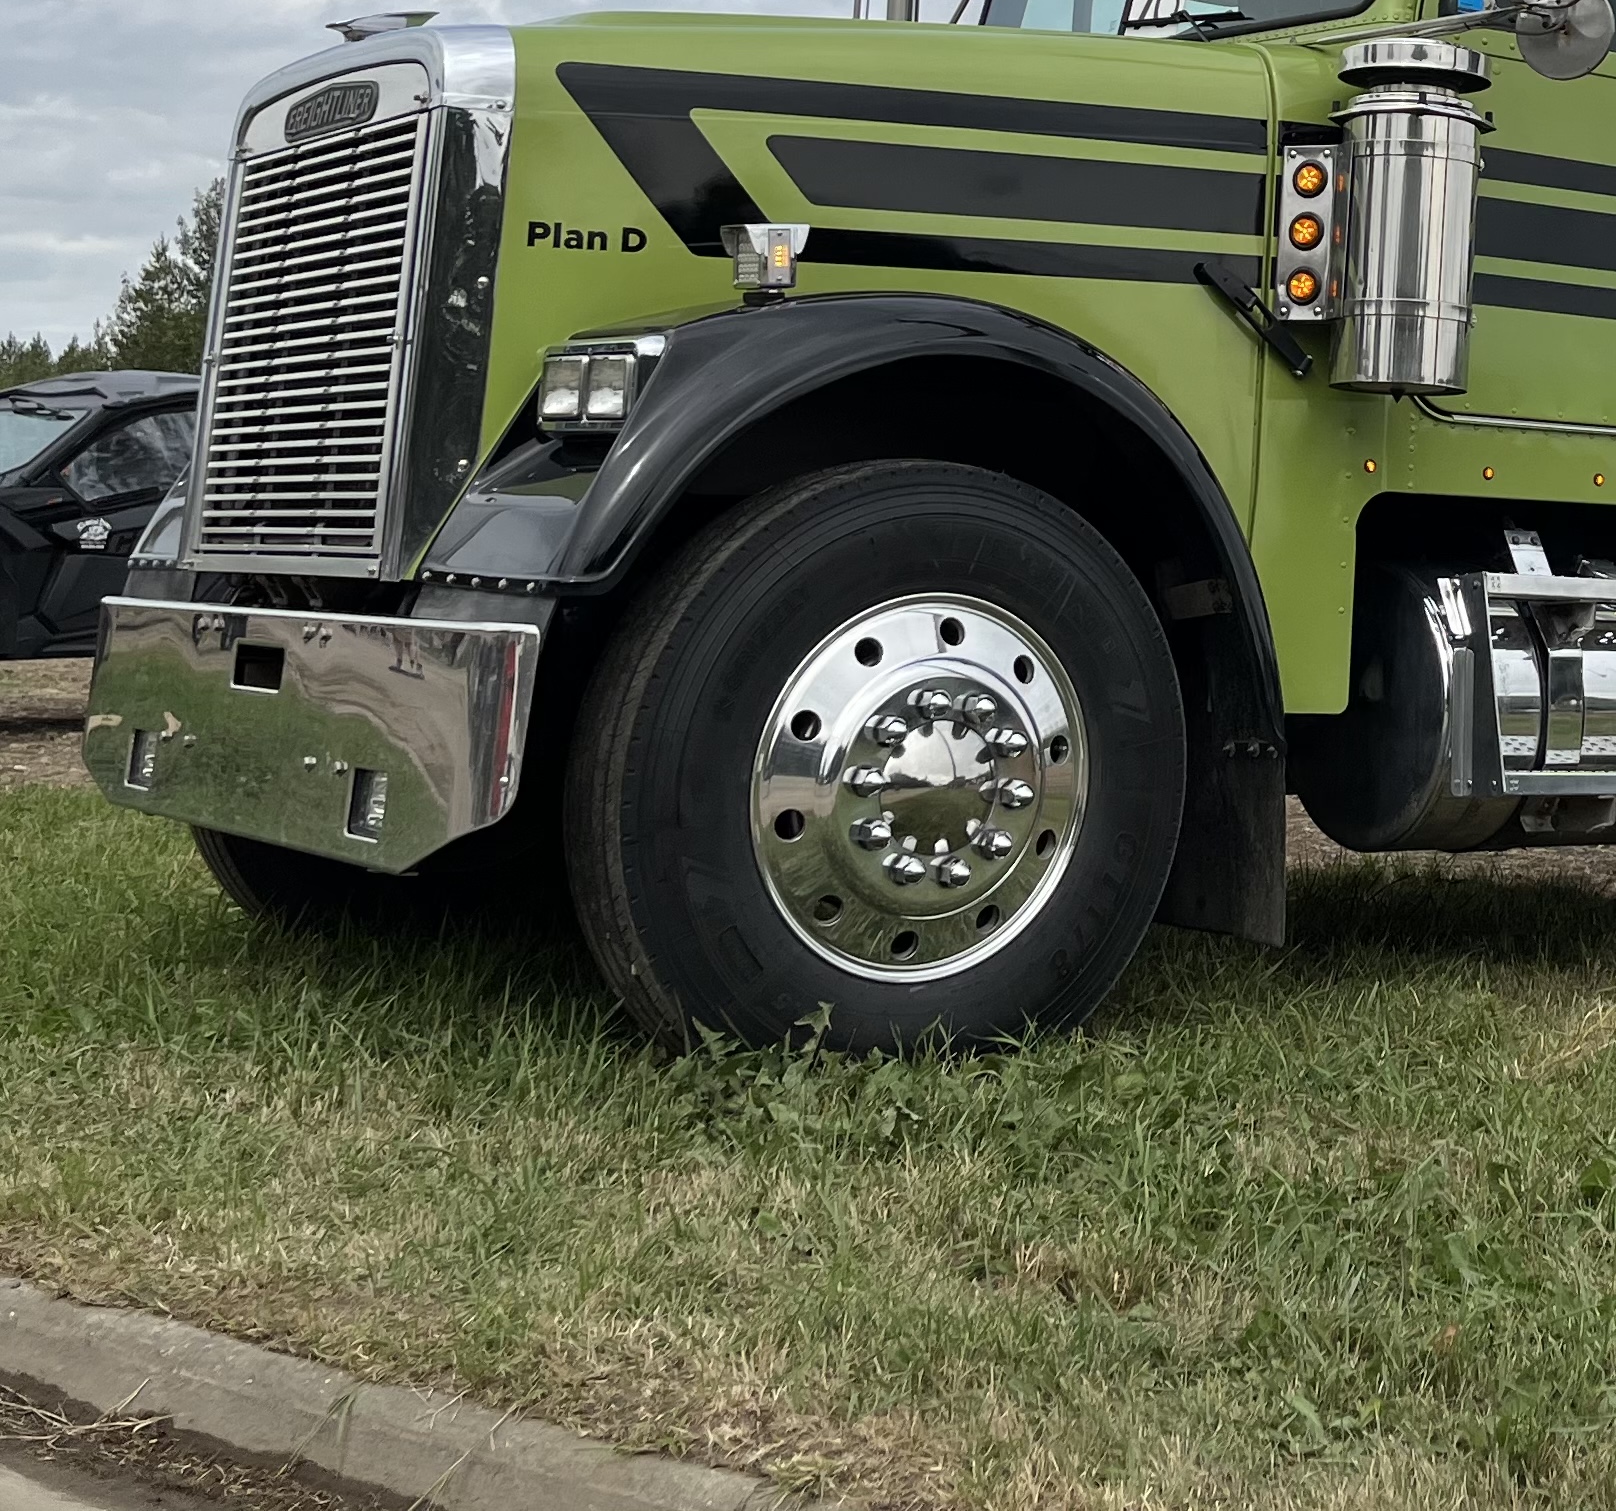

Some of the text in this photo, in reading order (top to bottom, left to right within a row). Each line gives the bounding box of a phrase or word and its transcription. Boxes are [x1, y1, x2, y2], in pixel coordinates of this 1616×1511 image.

[286, 88, 372, 134] FREIGHTLINER
[526, 221, 648, 253] Plan D
